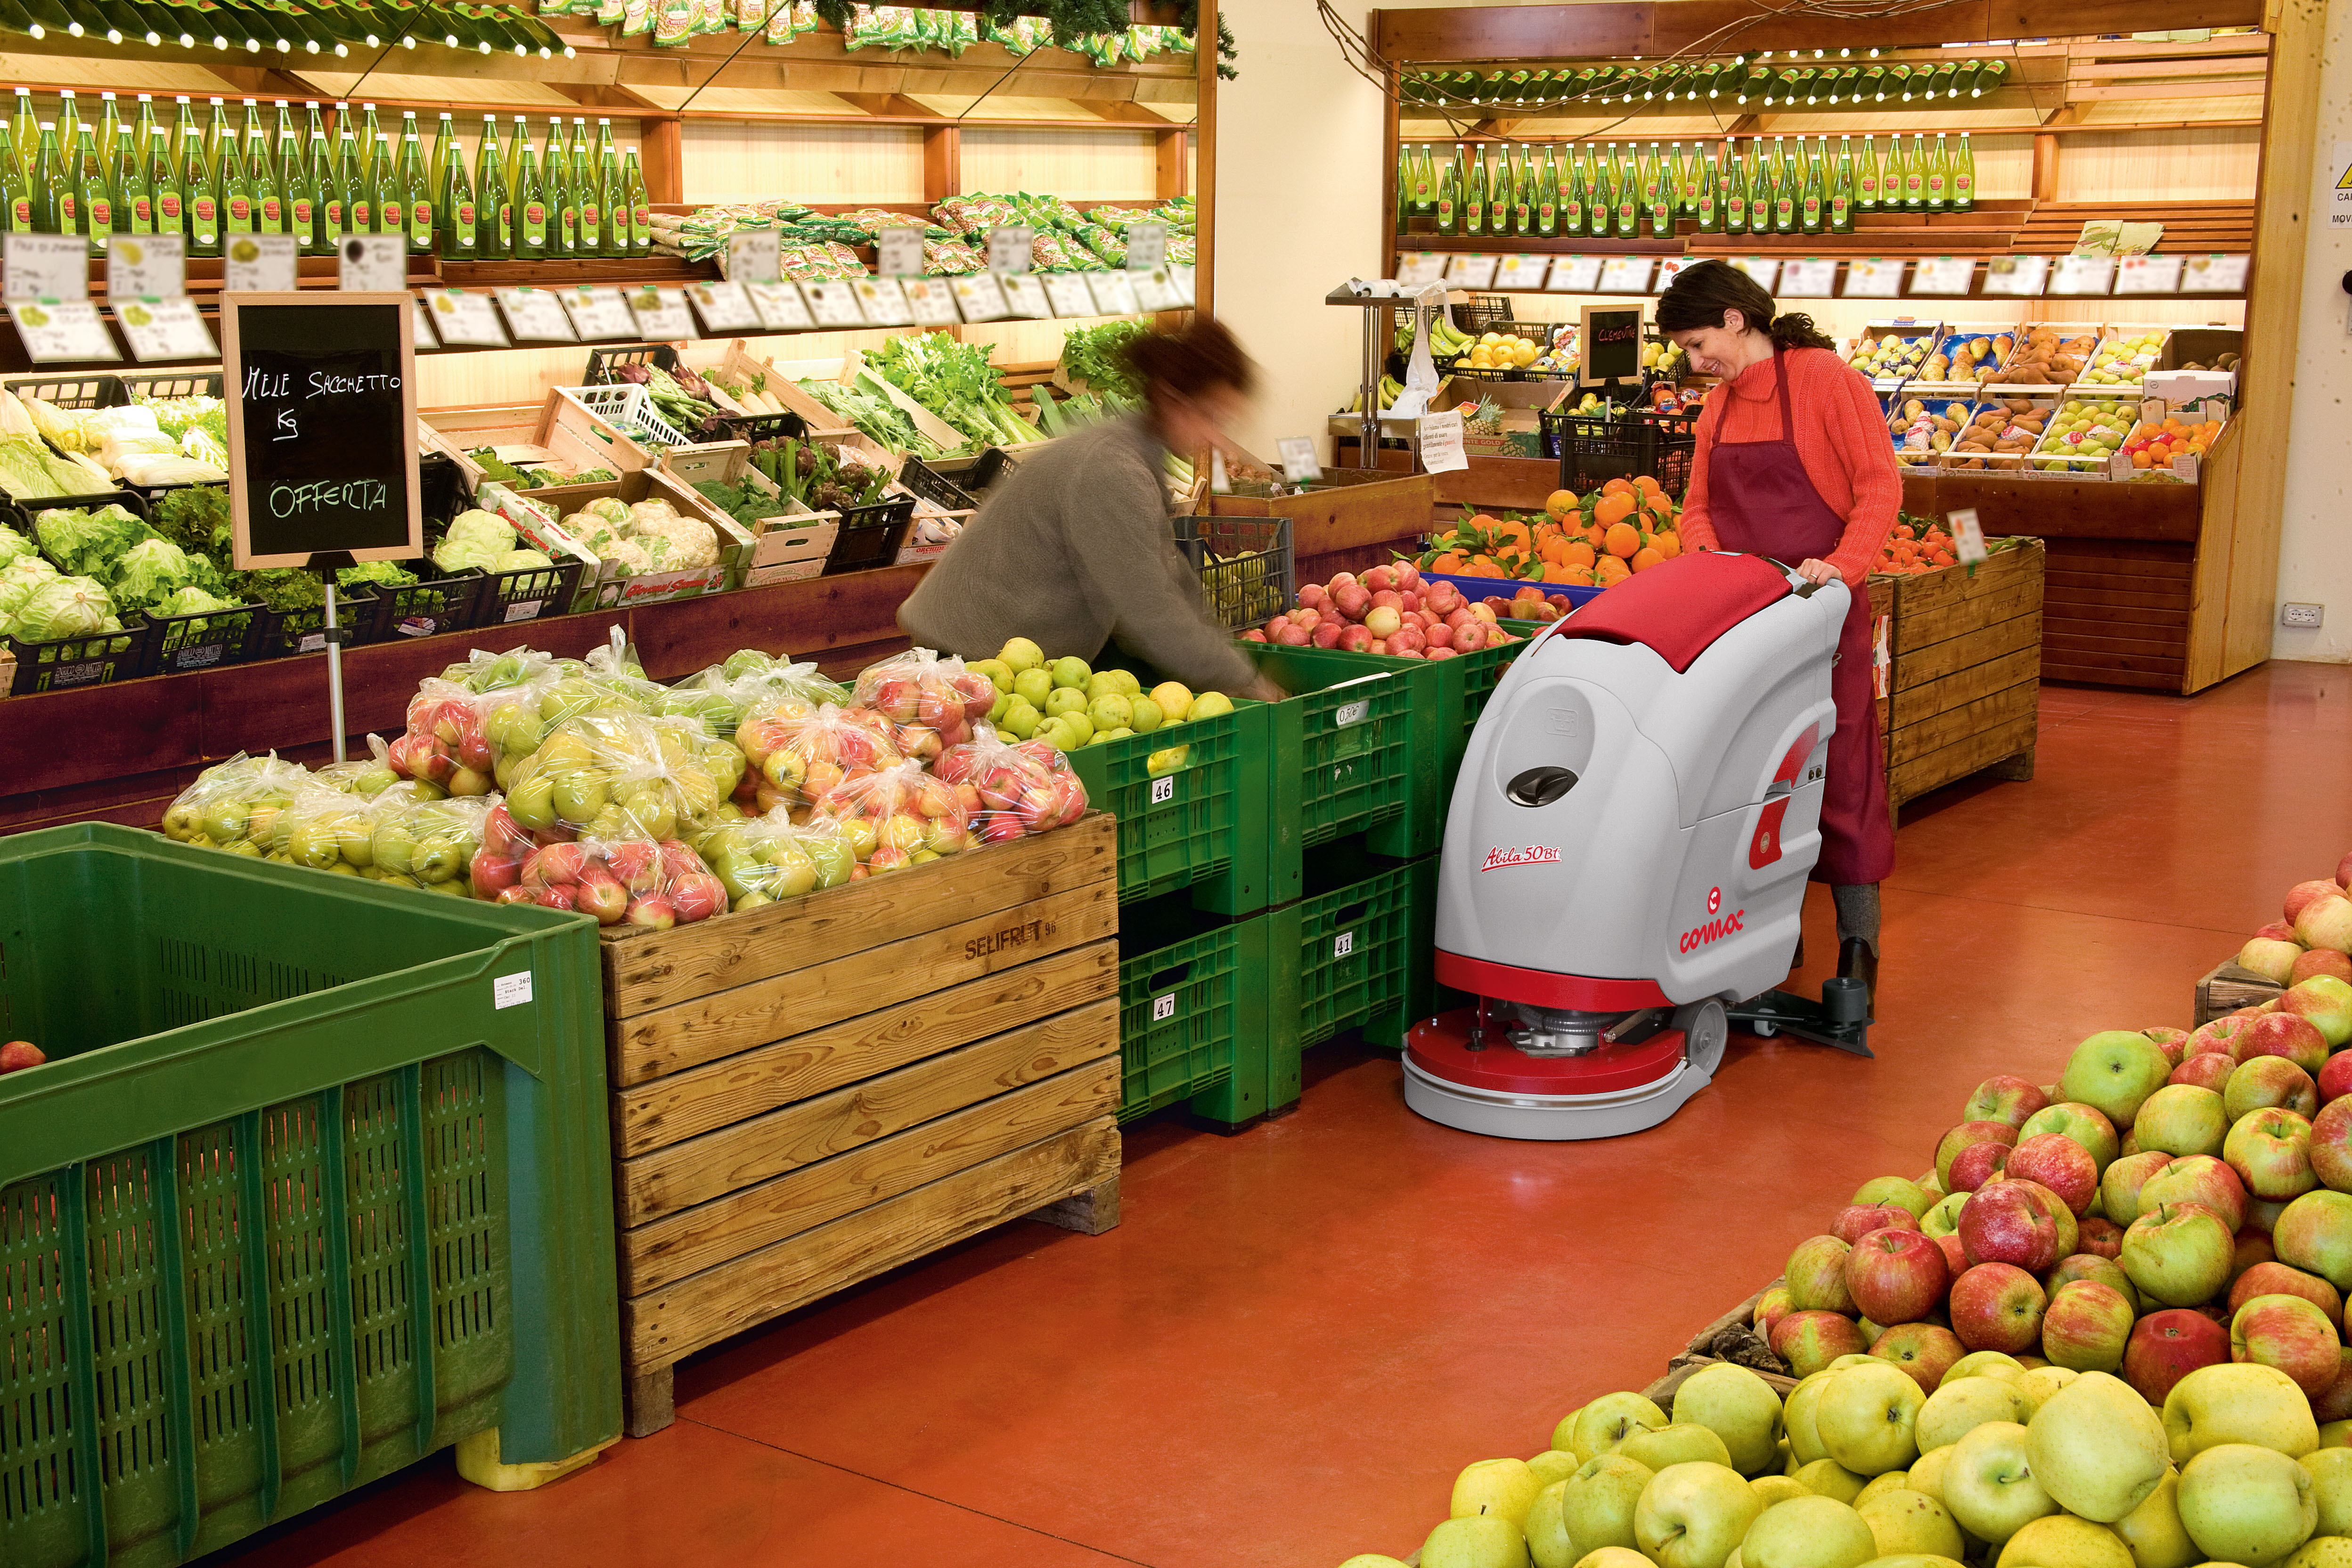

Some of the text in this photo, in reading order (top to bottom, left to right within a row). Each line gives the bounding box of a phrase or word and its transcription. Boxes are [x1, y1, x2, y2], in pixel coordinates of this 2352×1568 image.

[2337, 193, 2352, 201] CA
[2333, 215, 2352, 223] MOV
[242, 366, 401, 400] MELE SACCHETTO
[273, 408, 298, 441] Kg
[1423, 432, 1434, 440] clienti
[1423, 441, 1443, 450] gentilmente
[270, 479, 386, 518] OFFERTA
[84, 661, 104, 673] MATTEO
[1156, 783, 1170, 800] 46
[965, 920, 1043, 961] SELIFRUT
[1338, 938, 1350, 954] 41
[1157, 1000, 1172, 1017] 47
